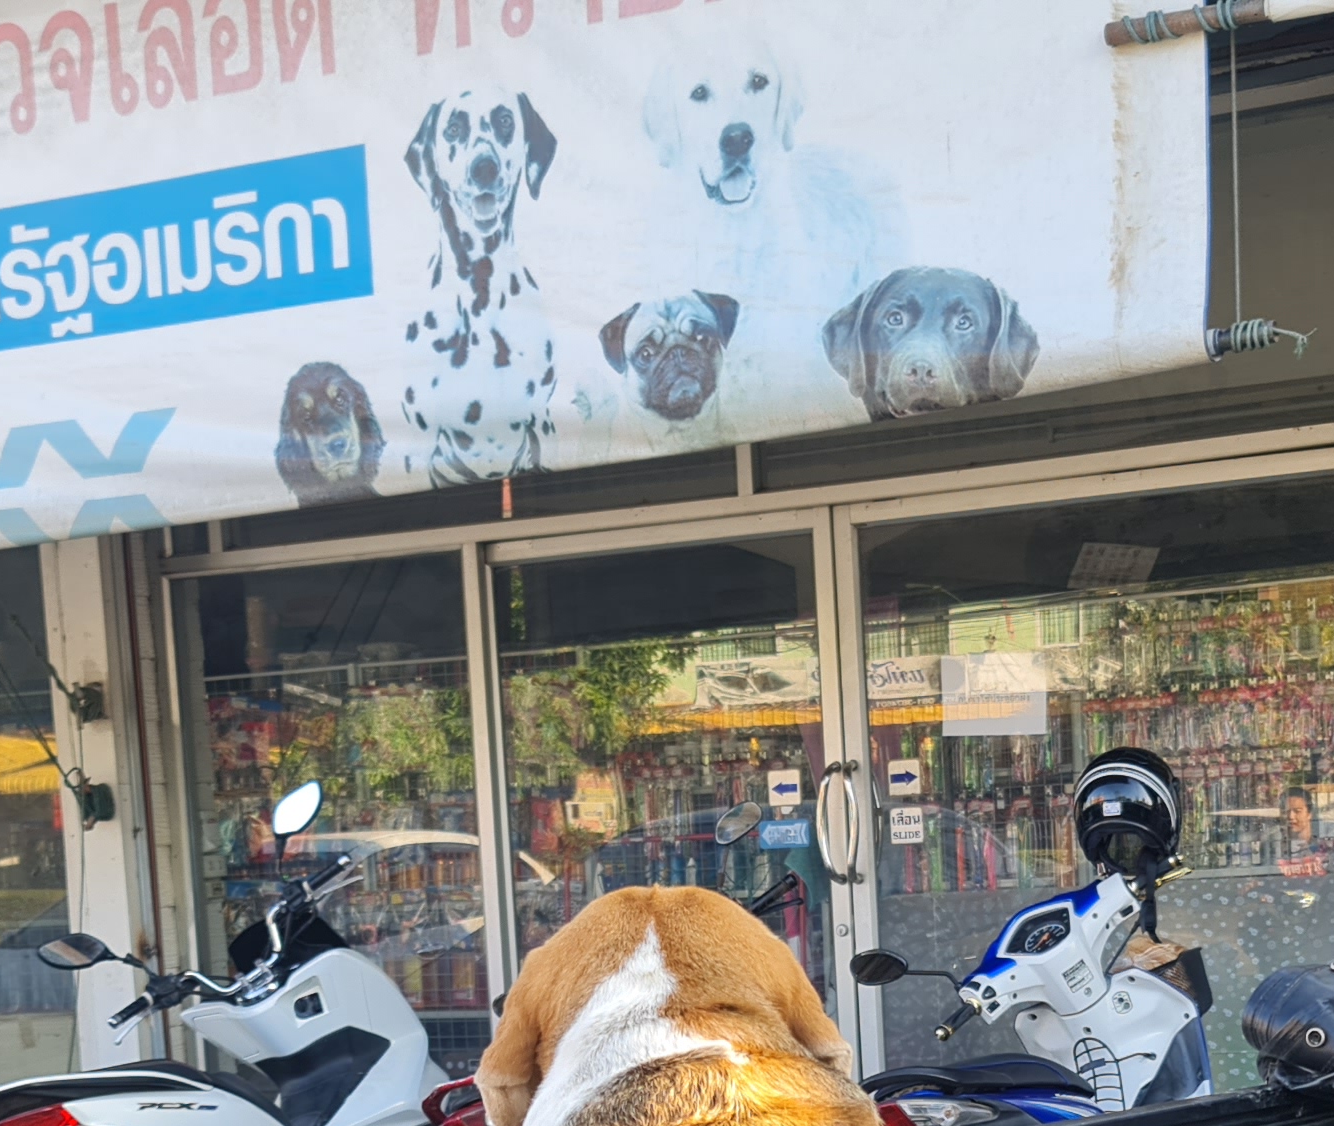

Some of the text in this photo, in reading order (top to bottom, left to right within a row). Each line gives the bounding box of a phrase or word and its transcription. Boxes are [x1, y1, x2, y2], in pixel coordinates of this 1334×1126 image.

[892, 810, 921, 826] เลื่อน
[893, 830, 921, 840] SLIDE
